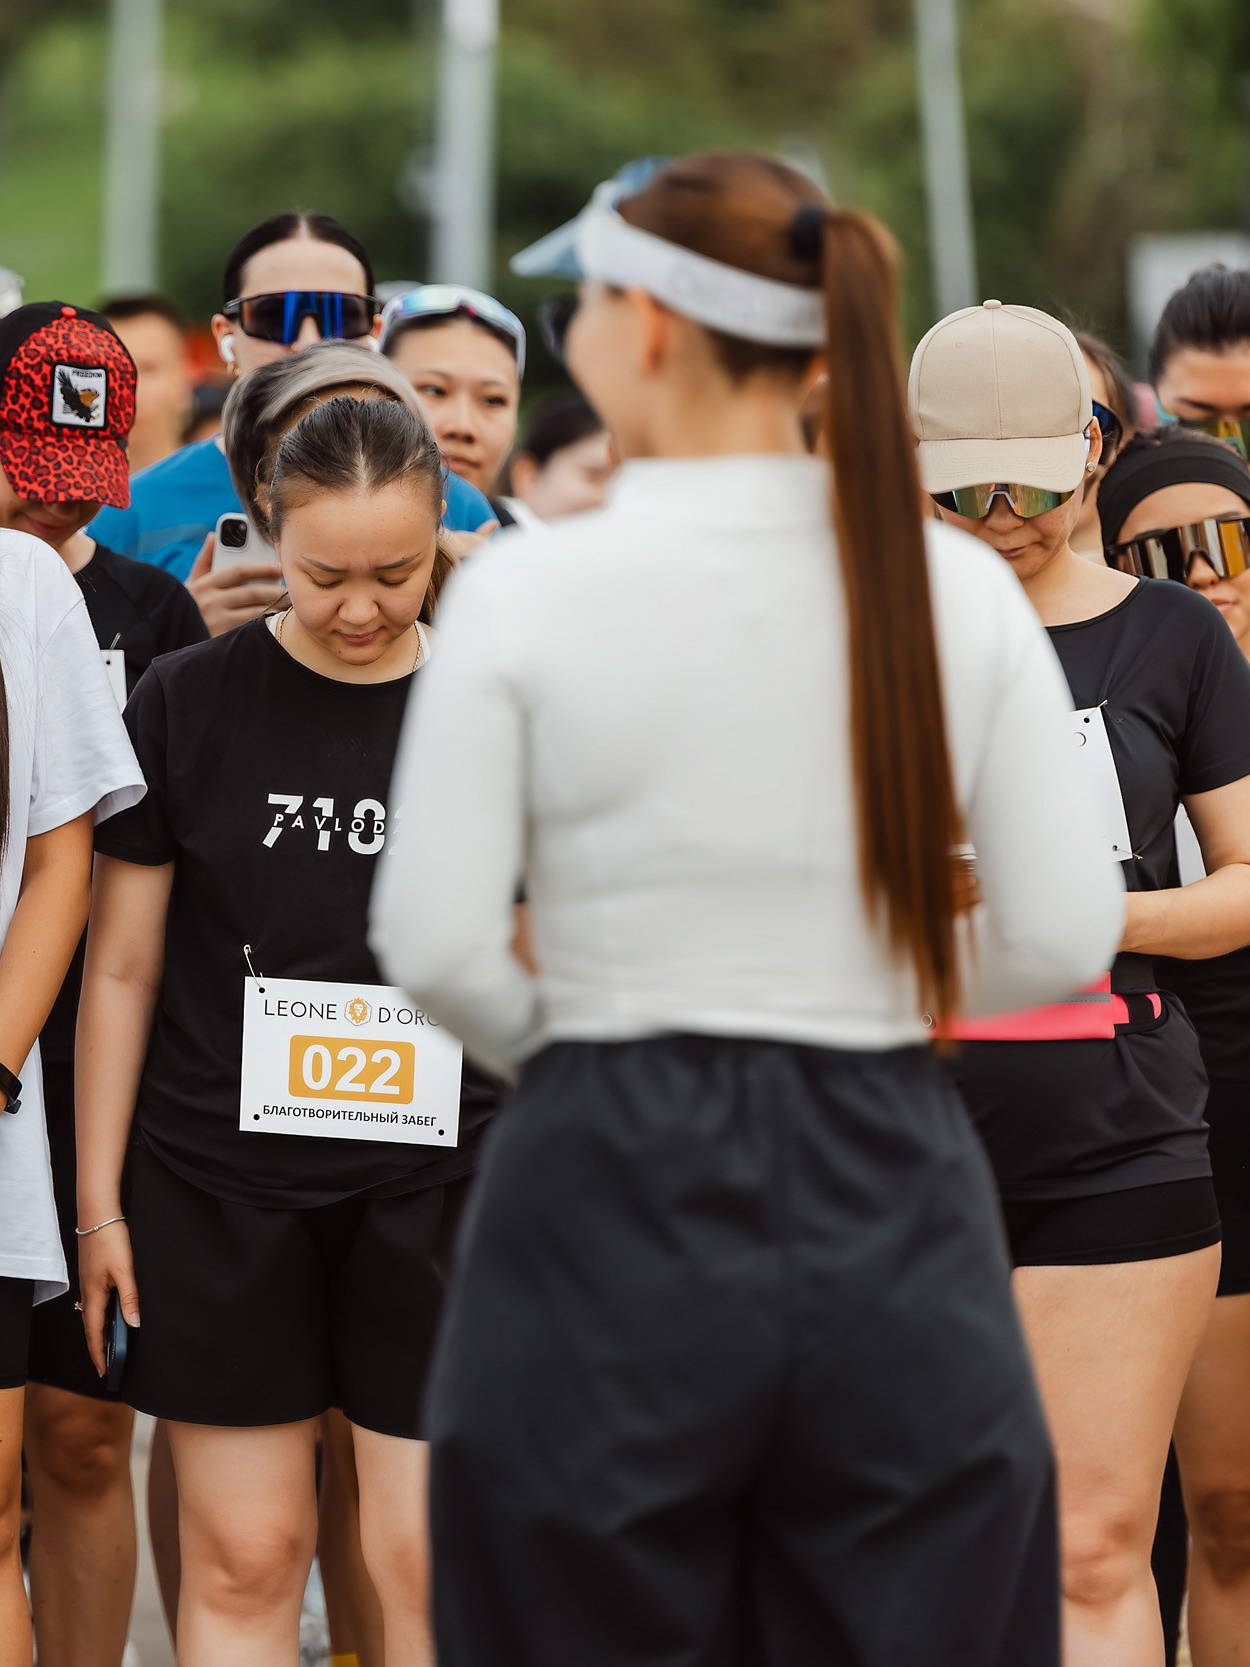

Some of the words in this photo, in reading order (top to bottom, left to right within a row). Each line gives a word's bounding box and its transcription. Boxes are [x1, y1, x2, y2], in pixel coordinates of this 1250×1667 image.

[273, 813, 386, 834] PAVLOD
[264, 999, 337, 1020] LEONE
[302, 1044, 401, 1095] 022
[263, 1105, 398, 1124] БЛАГОТВОРИТЕЛЬНЫЙ
[401, 1114, 437, 1127] ЗАБЕГ
